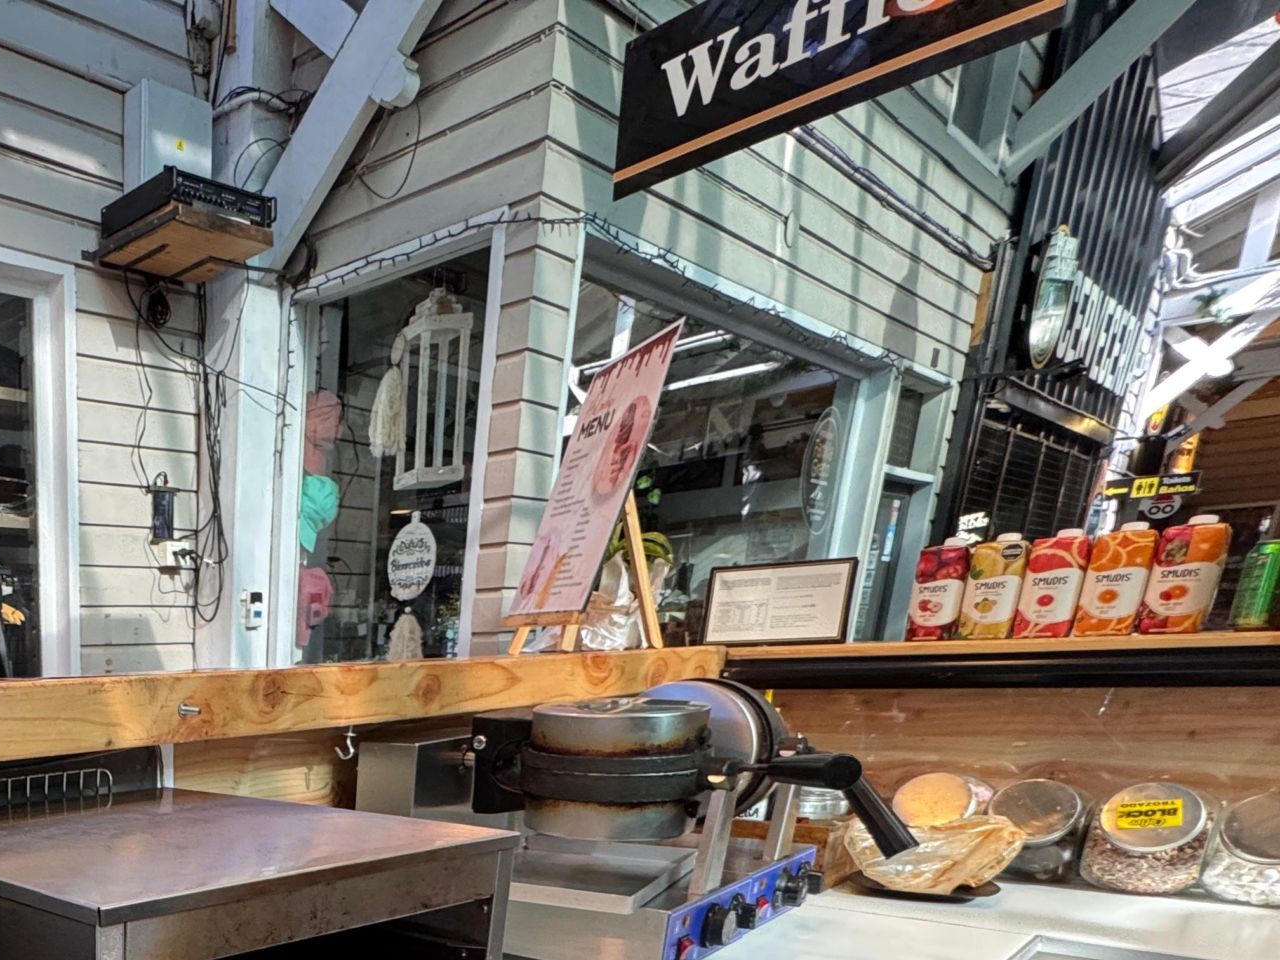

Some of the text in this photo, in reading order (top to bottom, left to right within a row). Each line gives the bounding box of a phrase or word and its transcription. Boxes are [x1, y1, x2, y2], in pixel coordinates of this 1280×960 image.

[577, 408, 616, 442] MENU
[1158, 484, 1196, 494] Baños
[1095, 573, 1132, 583] SMUDIS
[1161, 568, 1201, 578] SMUDIS
[974, 581, 1007, 590] SMUDIS
[1032, 576, 1070, 586] SMUDIS
[918, 585, 949, 594] SMUDIS
[1117, 808, 1179, 818] BLOCK
